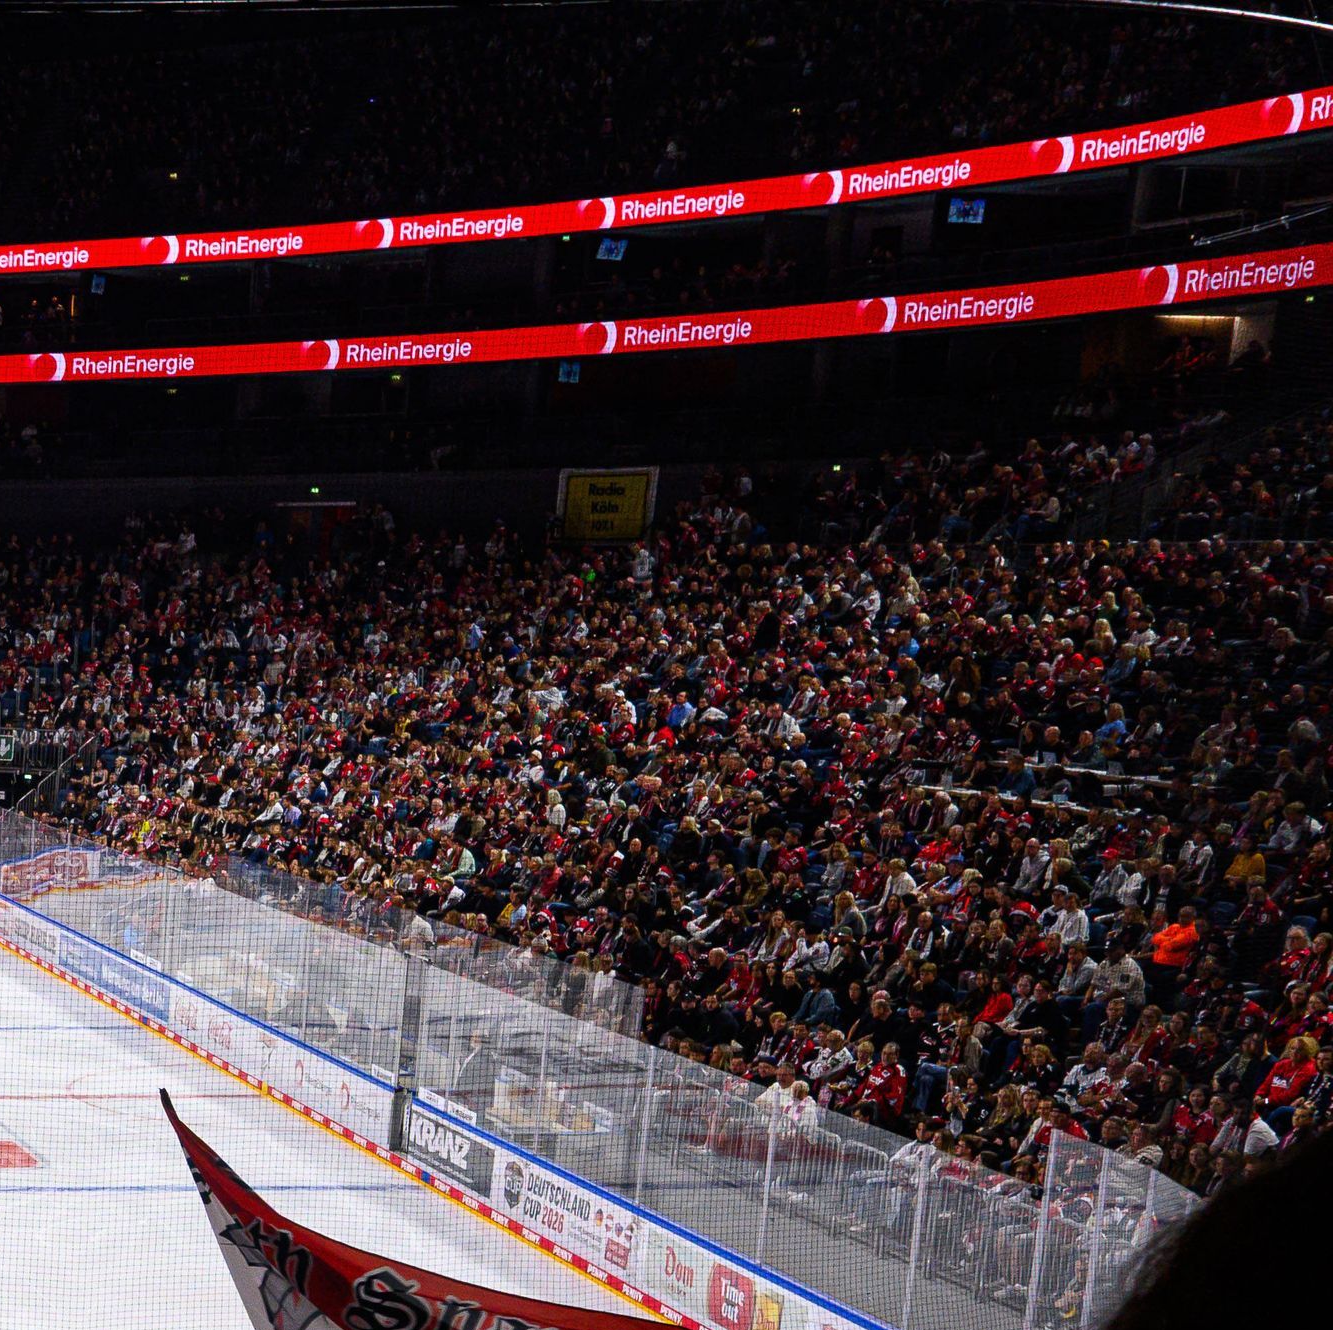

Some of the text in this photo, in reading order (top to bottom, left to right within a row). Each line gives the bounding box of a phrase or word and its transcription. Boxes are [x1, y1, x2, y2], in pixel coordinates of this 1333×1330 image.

[1081, 122, 1205, 163] RheinEnergie
[848, 160, 971, 195] RheinEnergie
[621, 190, 745, 221] RheinEnergie
[399, 214, 524, 242] RheinEnergie
[185, 232, 303, 258] RheinEnergie
[1184, 257, 1316, 293] RheinEnergie
[904, 293, 1034, 324] RheinEnergie
[623, 319, 752, 346] RheinEnergie
[71, 354, 194, 377] RheinEnergie
[346, 339, 472, 364] RheinEnergie
[589, 482, 626, 496] Radio
[591, 501, 620, 515] Köln
[409, 1113, 471, 1169] KRANZ
[527, 1173, 591, 1221] DEUTSCHLAND
[523, 1198, 565, 1233] CUP 2026
[665, 1245, 694, 1288] Dom
[720, 1276, 745, 1307] Time
[721, 1302, 739, 1323] out
